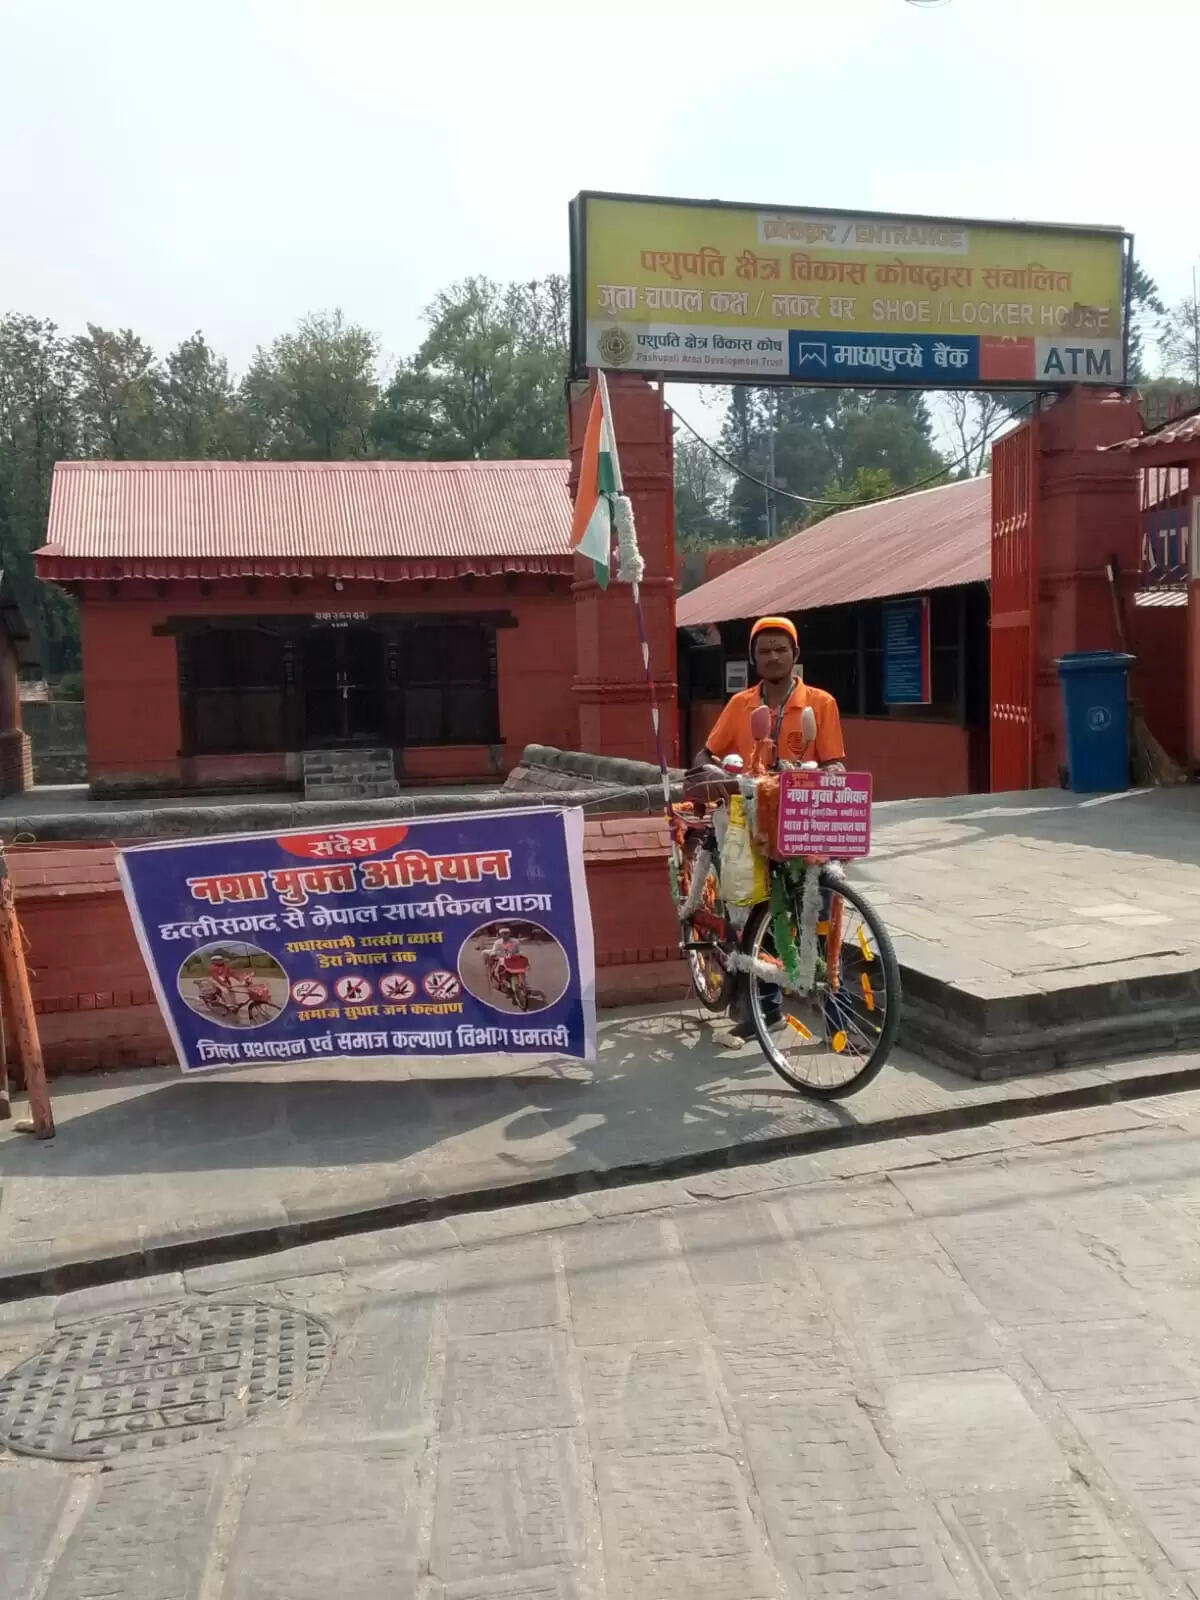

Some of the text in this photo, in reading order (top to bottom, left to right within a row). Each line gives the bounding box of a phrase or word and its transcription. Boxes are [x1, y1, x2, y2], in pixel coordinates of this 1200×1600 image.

[856, 225, 963, 247] ENTRANCE
[639, 246, 1073, 293] पशुपति क्षेत्र विकास कोषद्वारा संचालित
[709, 290, 749, 316] कक्ष
[771, 294, 823, 319] लकर
[829, 297, 857, 320] घर
[872, 299, 931, 323] SHOE
[950, 302, 1034, 325] LOCKER
[636, 332, 783, 351] पशुपति क्षेत्र विकास कोष
[637, 352, 784, 368] Pashupati Area Development Trust
[931, 342, 970, 368] बैंक
[1043, 348, 1113, 376] ATM
[308, 835, 377, 856] संदेश
[186, 849, 513, 906] नशा मुक्त अभियान
[280, 907, 304, 929] से
[309, 905, 378, 926] नेपाल
[382, 893, 493, 921] सायकिल
[494, 894, 553, 912] यात्रा
[285, 935, 356, 953] राधास्वामी
[344, 951, 388, 966] नेपाल
[390, 951, 417, 963] तक
[297, 1002, 464, 1022] समाज सुधार जन कल्याण
[196, 1024, 570, 1061] जिला प्रशासन एवं समाज कल्याण विभाग धमतरी
